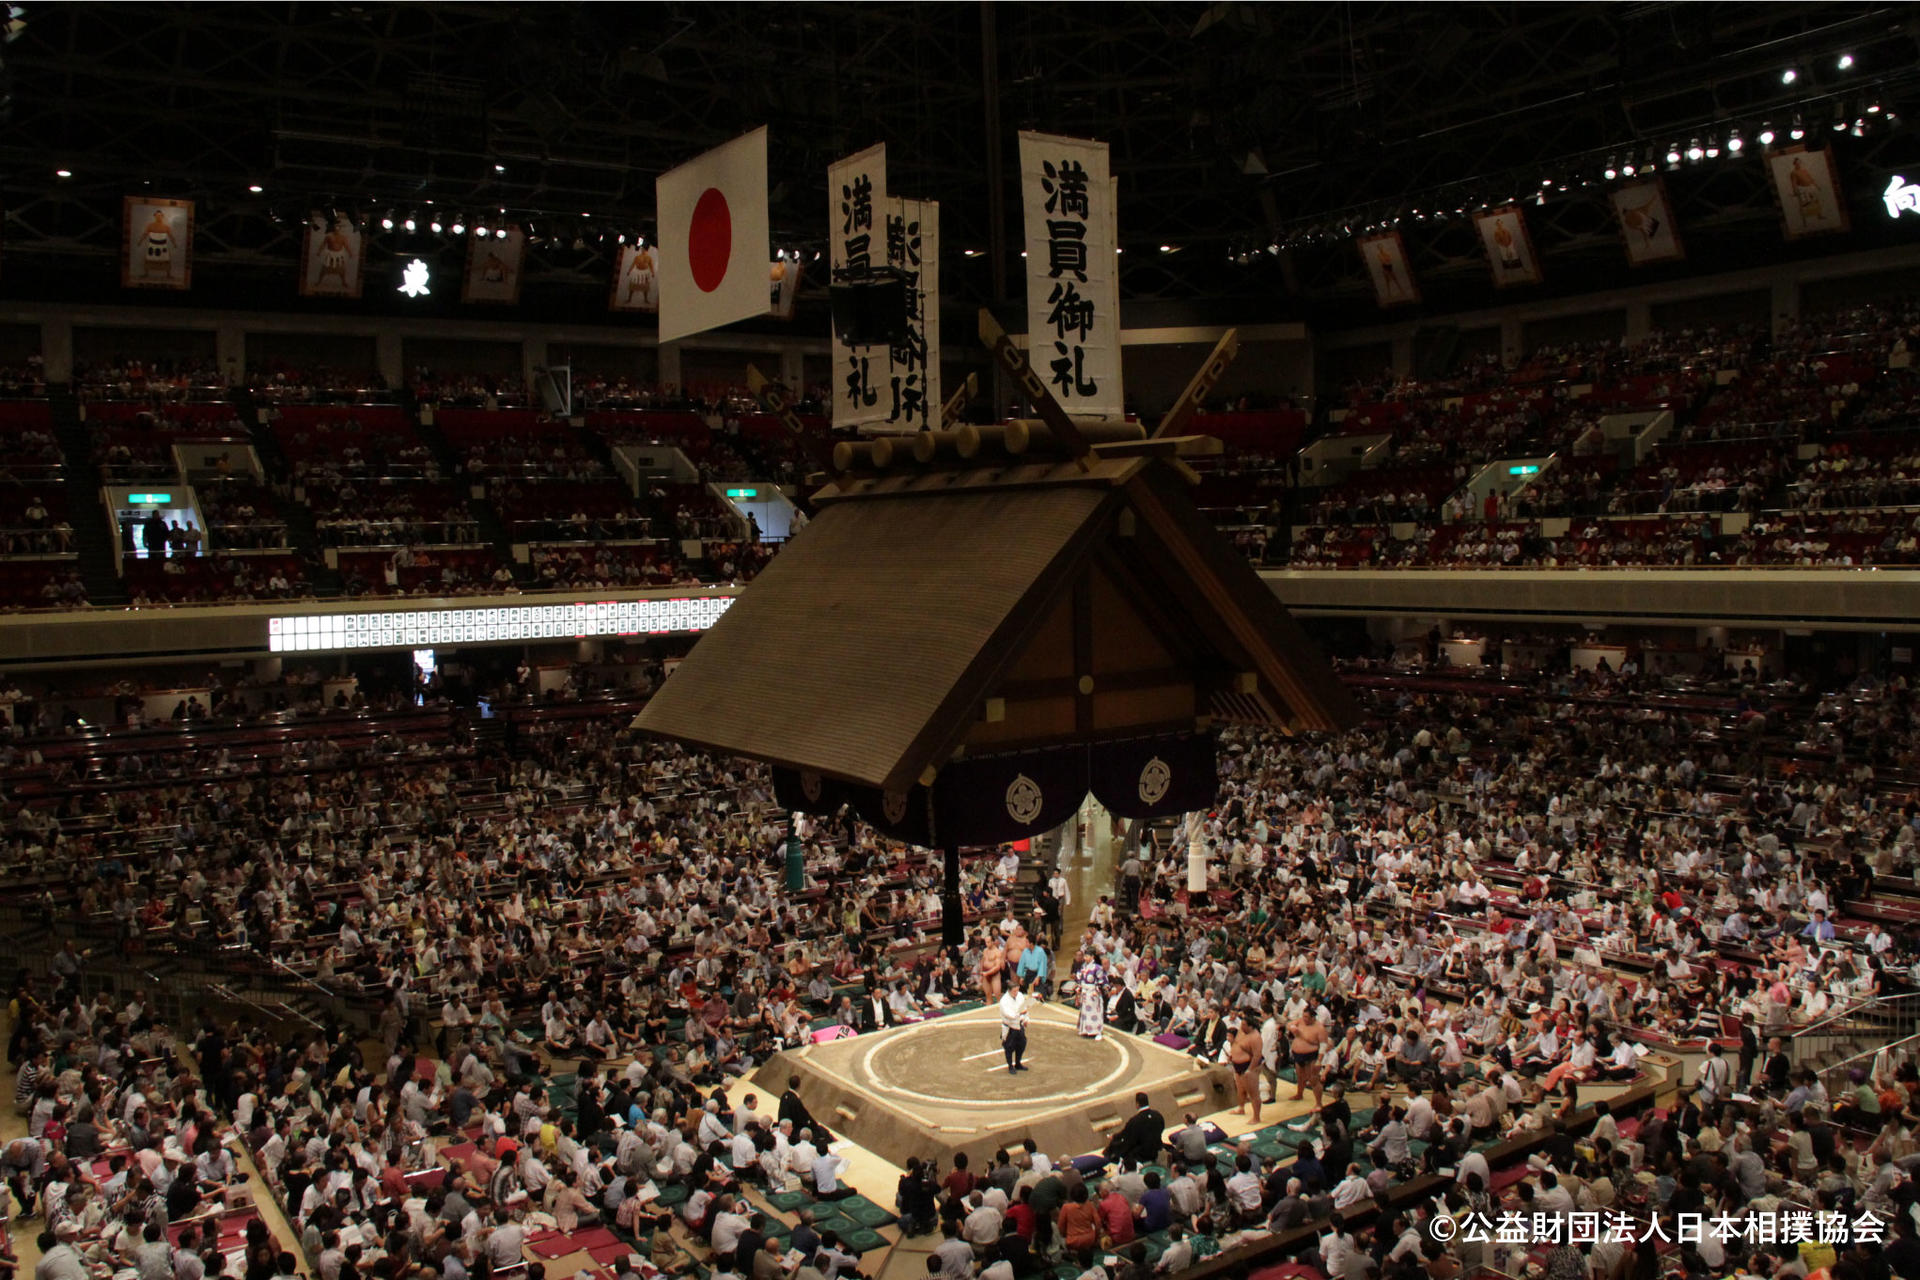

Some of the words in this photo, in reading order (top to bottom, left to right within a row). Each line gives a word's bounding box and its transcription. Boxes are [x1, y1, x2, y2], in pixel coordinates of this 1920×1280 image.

[842, 174, 878, 410] 満員礼
[1041, 159, 1098, 398] 満員御礼
